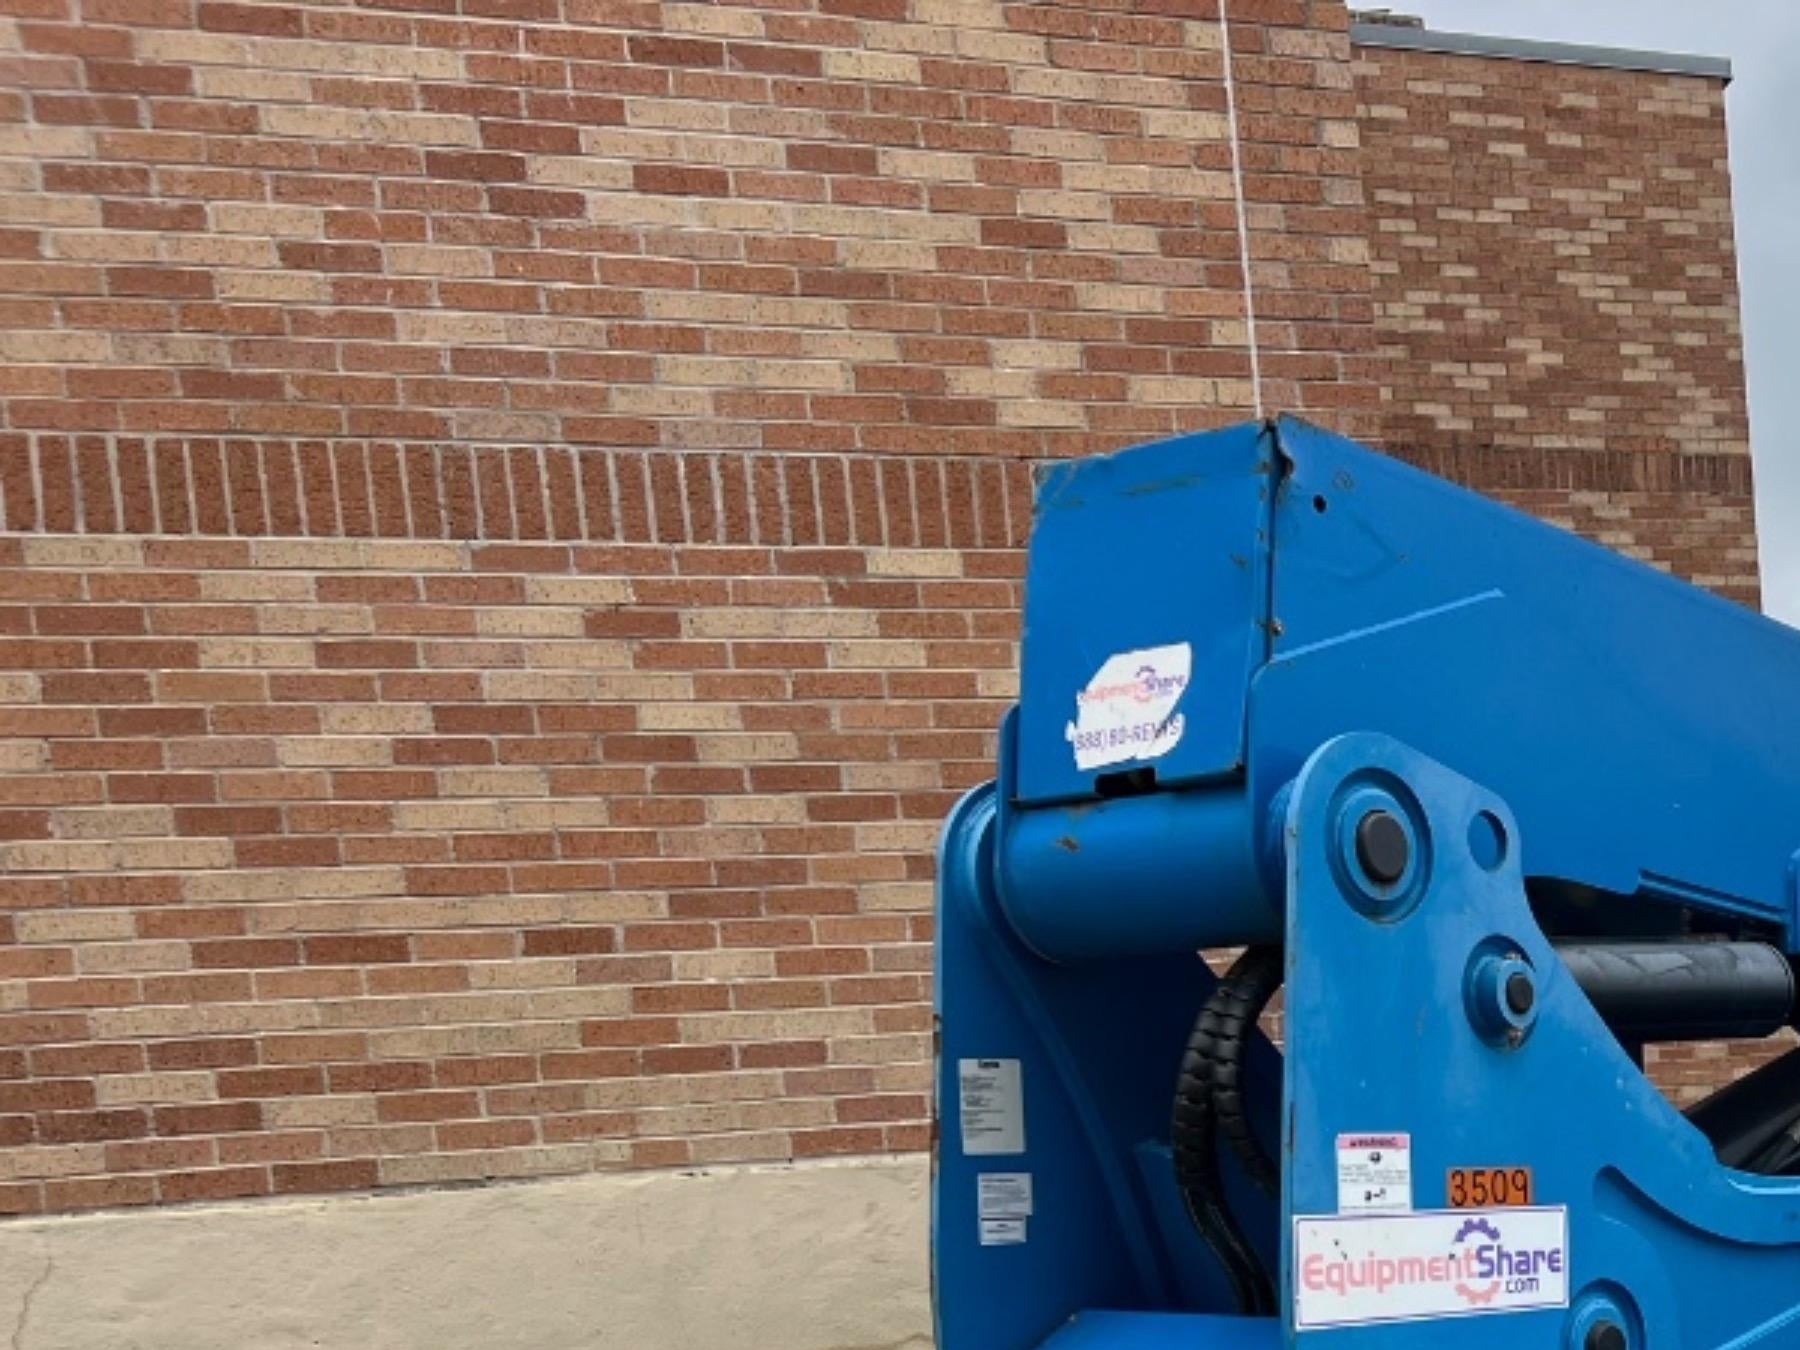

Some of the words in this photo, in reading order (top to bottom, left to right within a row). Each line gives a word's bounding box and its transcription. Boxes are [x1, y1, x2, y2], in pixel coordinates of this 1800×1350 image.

[1450, 1168, 1529, 1207] 3509
[1303, 1244, 1563, 1296] EquipmentShare
[1504, 1276, 1540, 1294] .com
